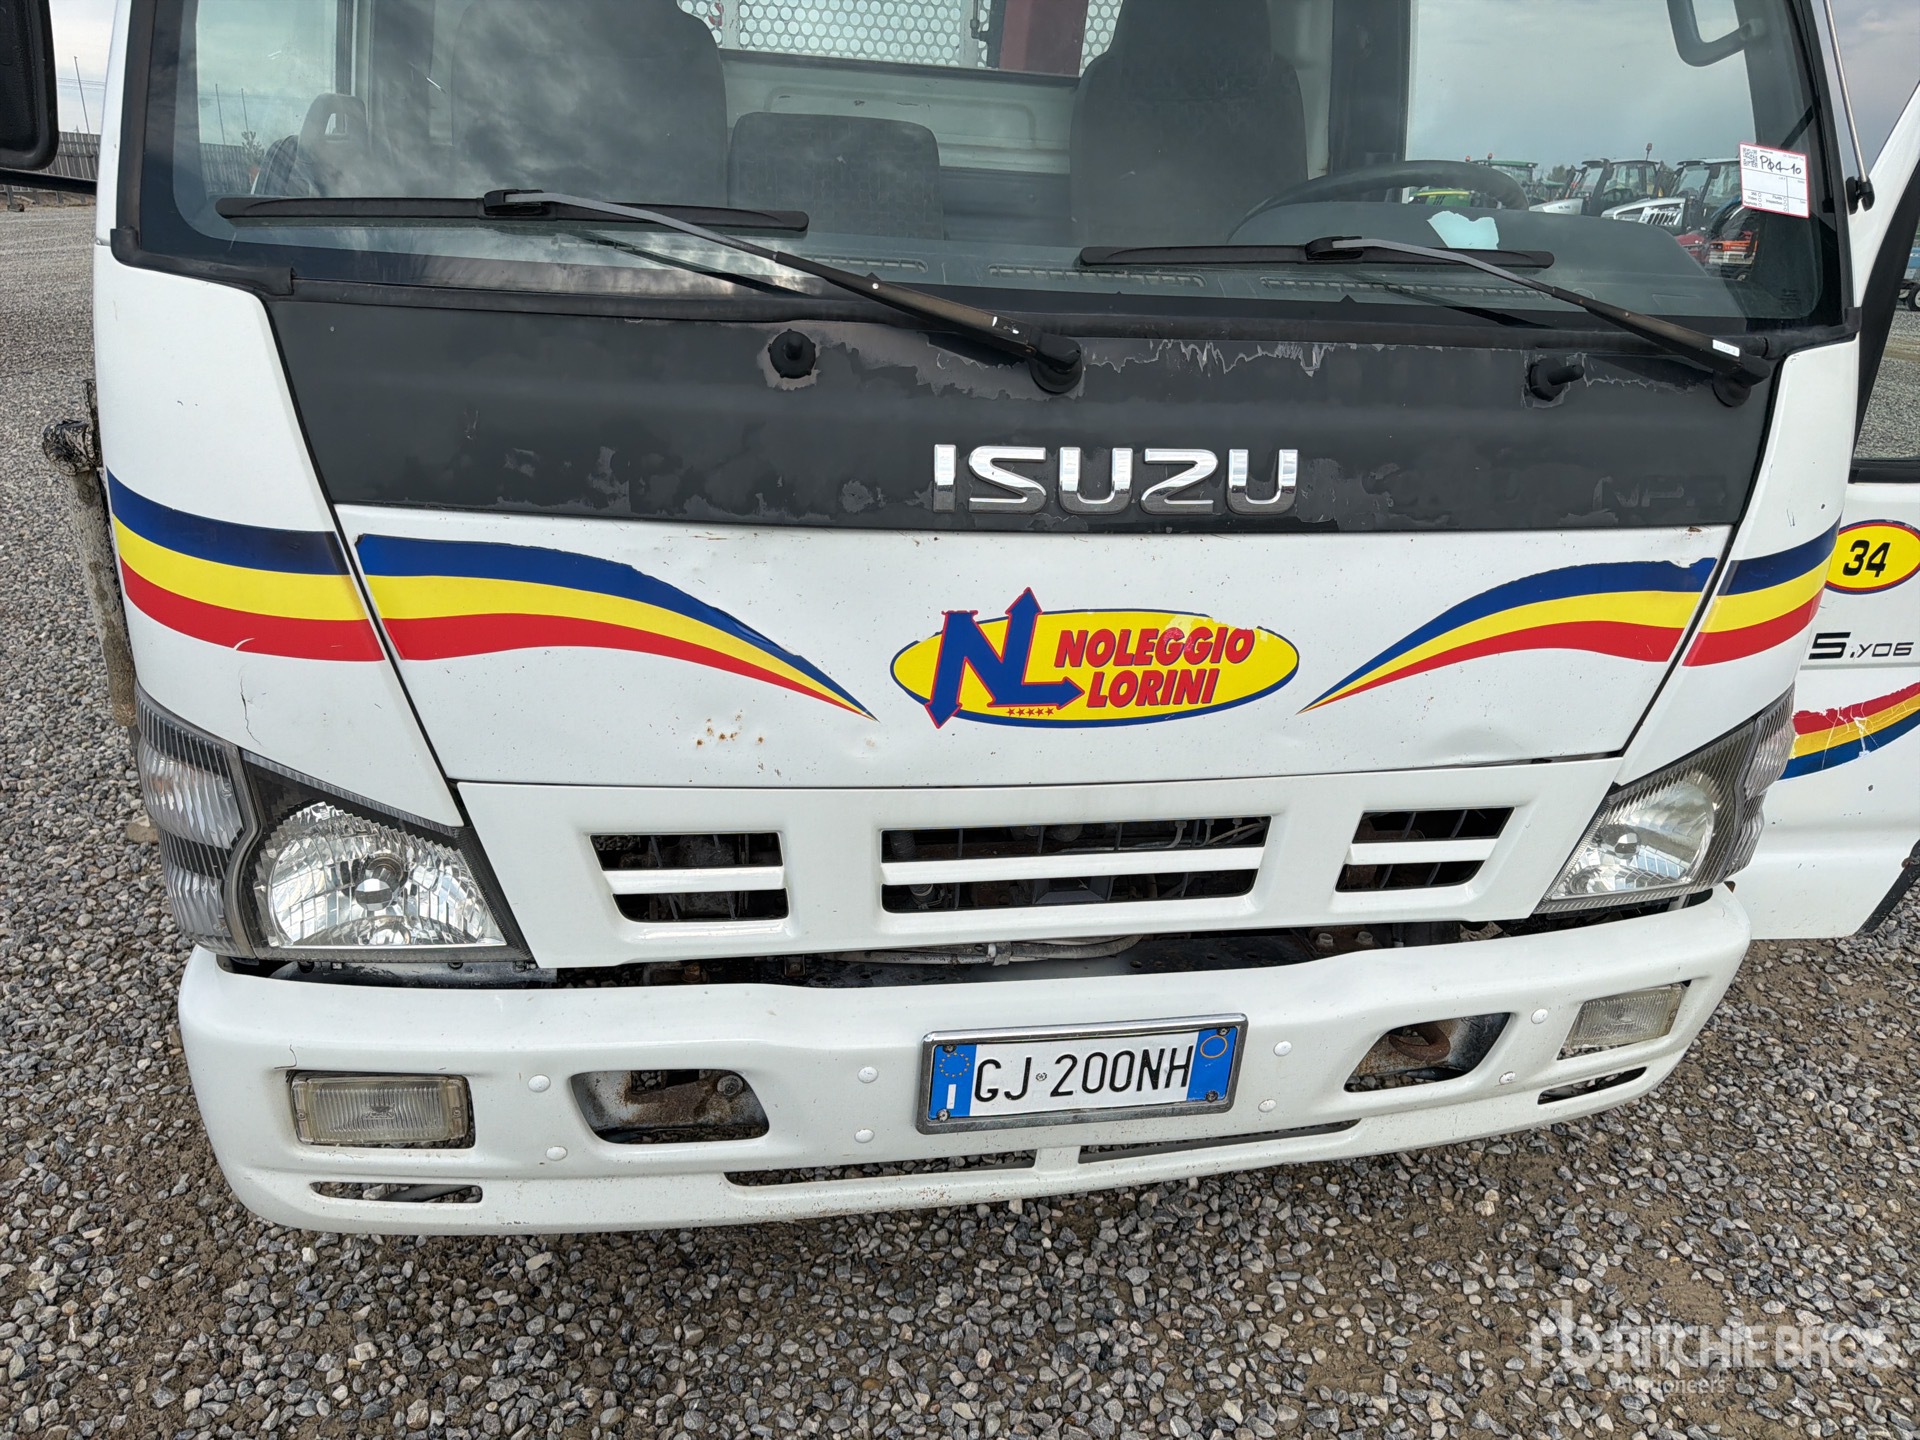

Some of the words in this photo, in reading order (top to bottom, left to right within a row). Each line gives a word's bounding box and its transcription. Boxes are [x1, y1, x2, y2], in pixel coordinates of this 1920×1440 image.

[933, 444, 1299, 515] ISUZU
[1842, 539, 1891, 578] 34
[1054, 626, 1255, 669] NOLEGGIO
[1086, 668, 1220, 709] LORINI
[974, 1056, 1033, 1103] GJ
[1049, 1045, 1195, 1098] 200NH
